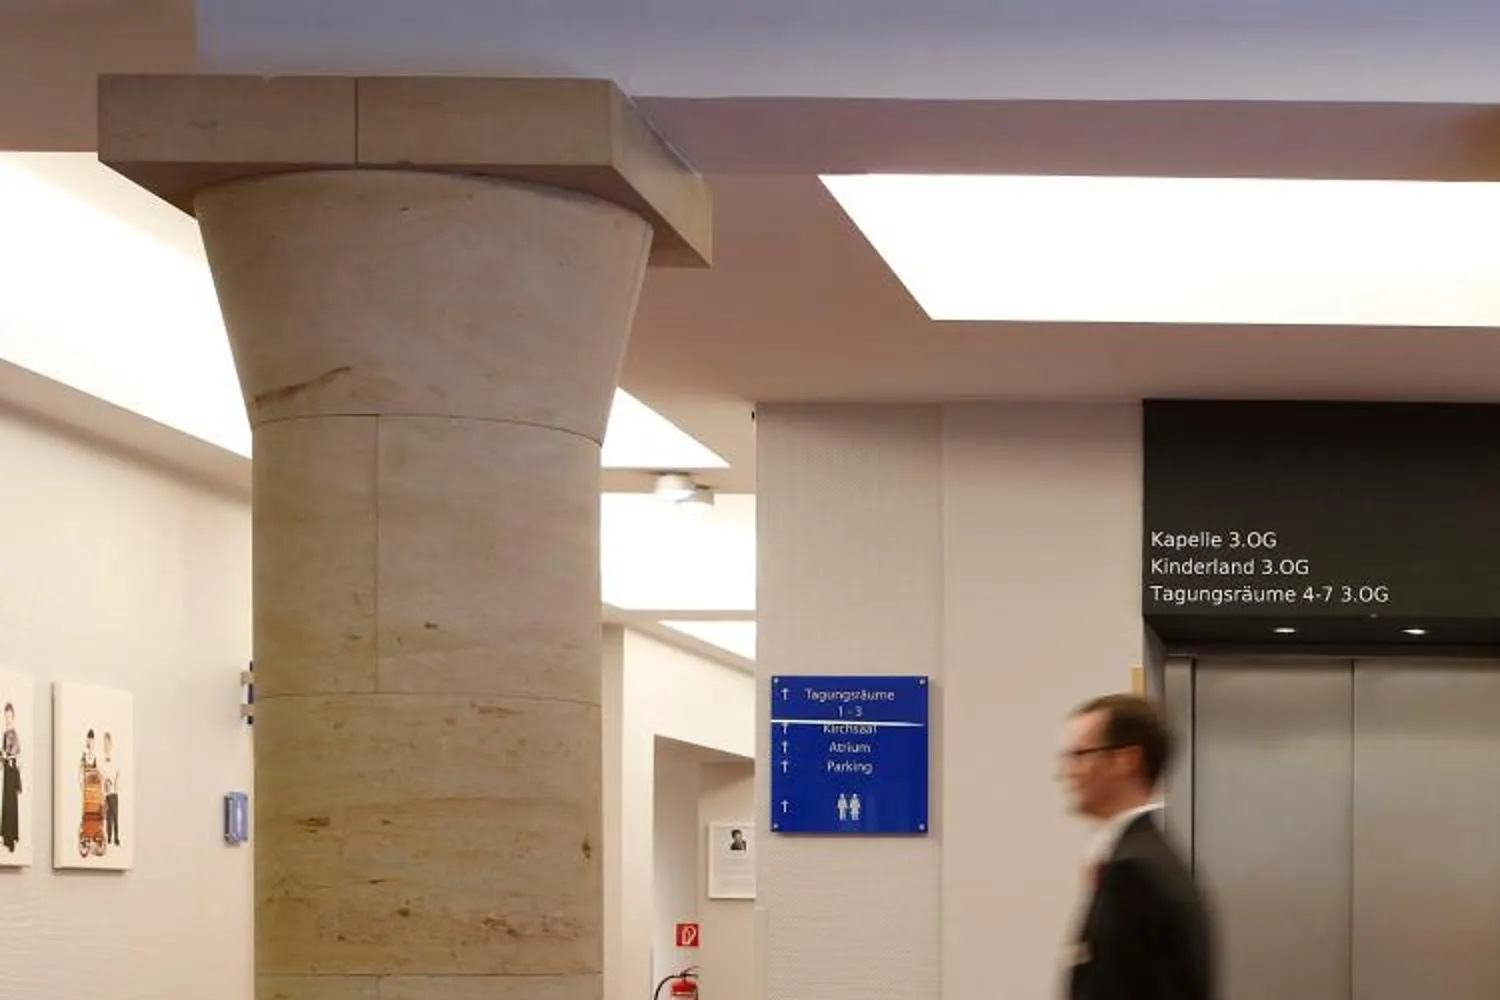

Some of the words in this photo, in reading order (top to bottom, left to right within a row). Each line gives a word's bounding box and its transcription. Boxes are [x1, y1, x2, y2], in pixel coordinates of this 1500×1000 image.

[1150, 531, 1222, 550] Kapelle
[1229, 531, 1278, 549] 3.OG
[1150, 558, 1255, 575] Kinderland
[1261, 559, 1310, 575] 3.OG
[1150, 585, 1297, 606] Tagungsräume
[1302, 586, 1333, 602] 4-7
[1341, 586, 1390, 602] 3.OG
[804, 687, 895, 703] Tagungsräume
[855, 706, 863, 717] 3
[829, 741, 871, 753] Atrium
[827, 760, 873, 774] Parking
